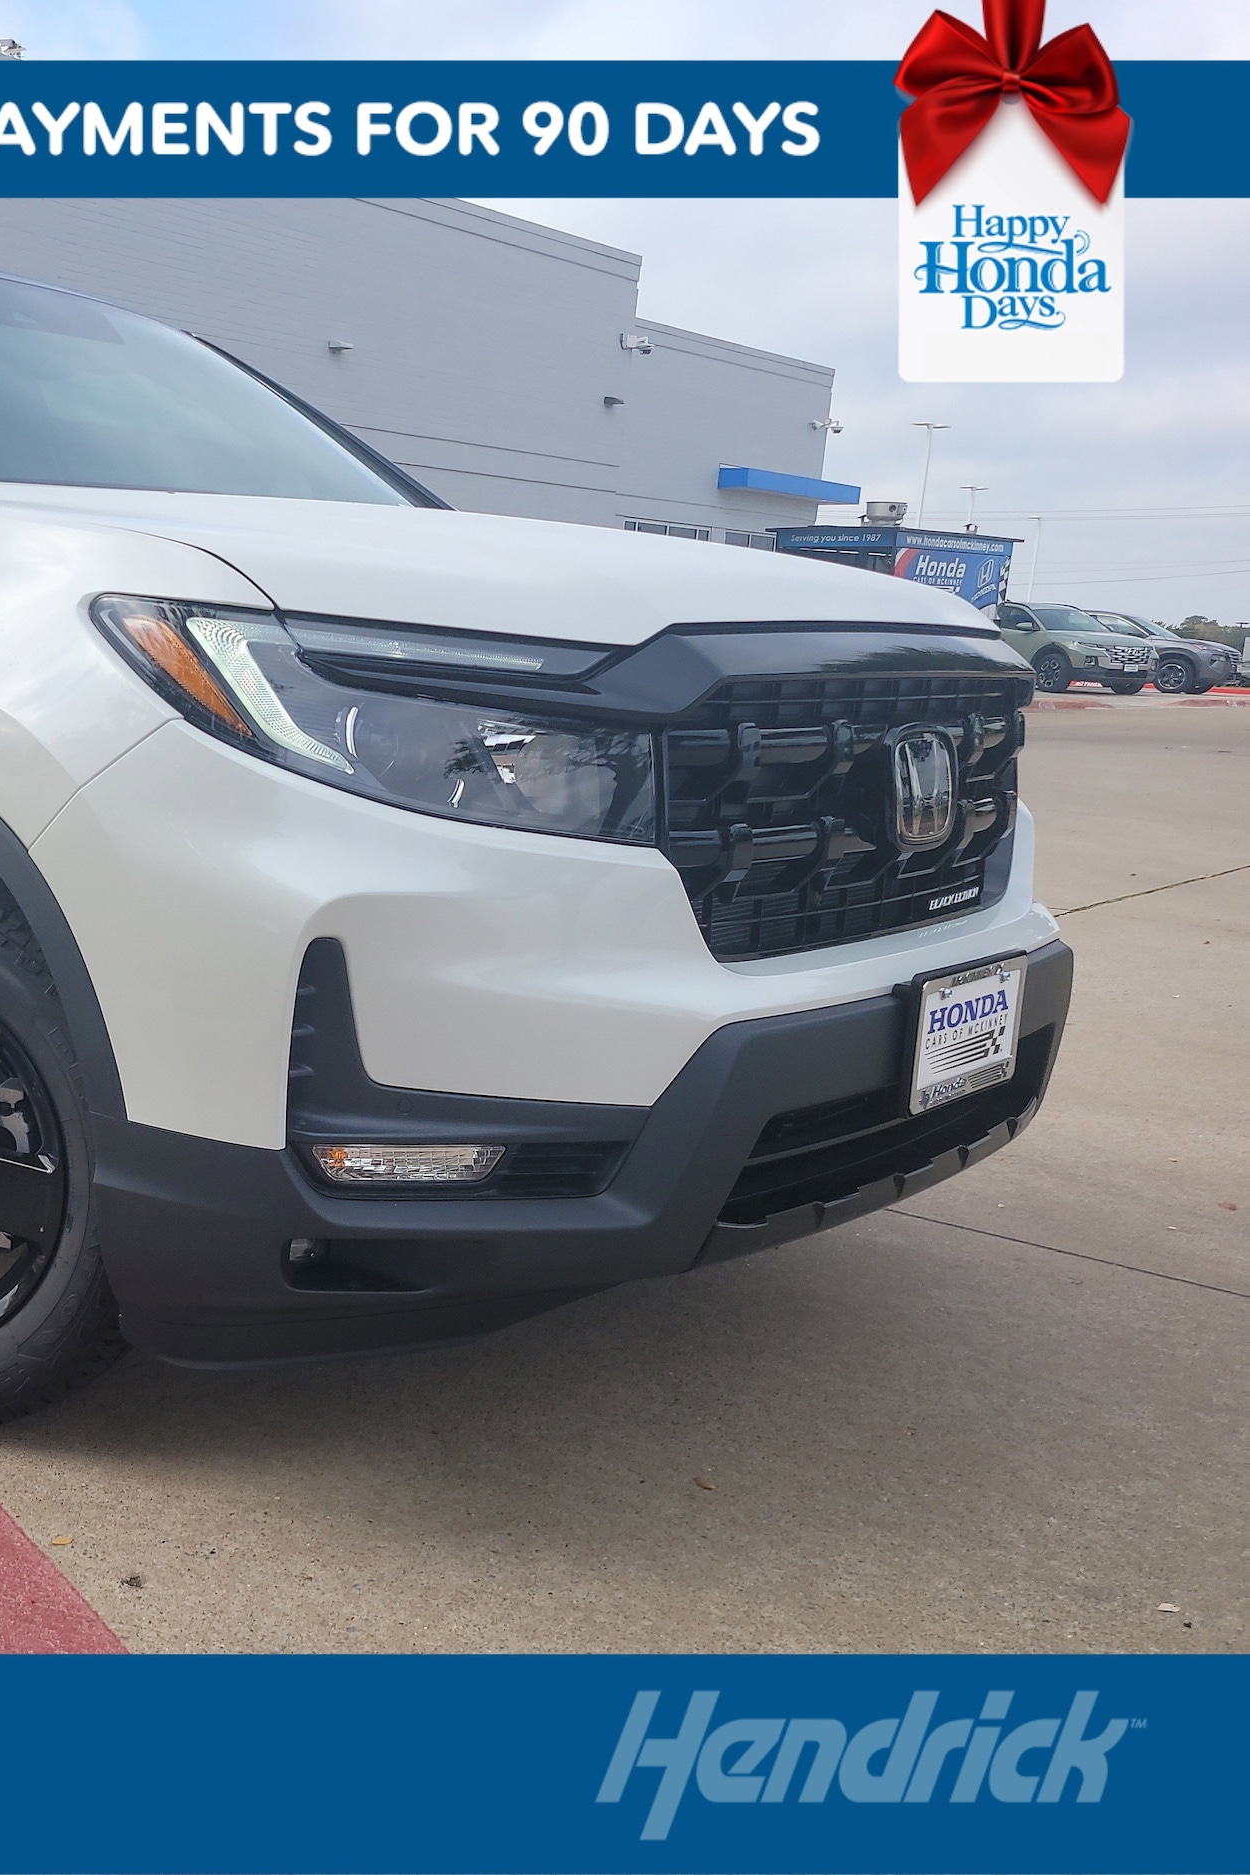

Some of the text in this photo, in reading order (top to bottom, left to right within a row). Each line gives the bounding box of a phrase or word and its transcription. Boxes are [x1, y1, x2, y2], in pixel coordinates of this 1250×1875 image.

[791, 534, 881, 543] Serving you since 1987
[906, 535, 1004, 553] www.hondacarsofmckinney.com
[915, 555, 966, 578] Honda
[929, 887, 979, 910] BLACK EDITION
[927, 989, 1009, 1035] HONDA
[925, 1013, 1008, 1050] CARS OF MCKINNEY
